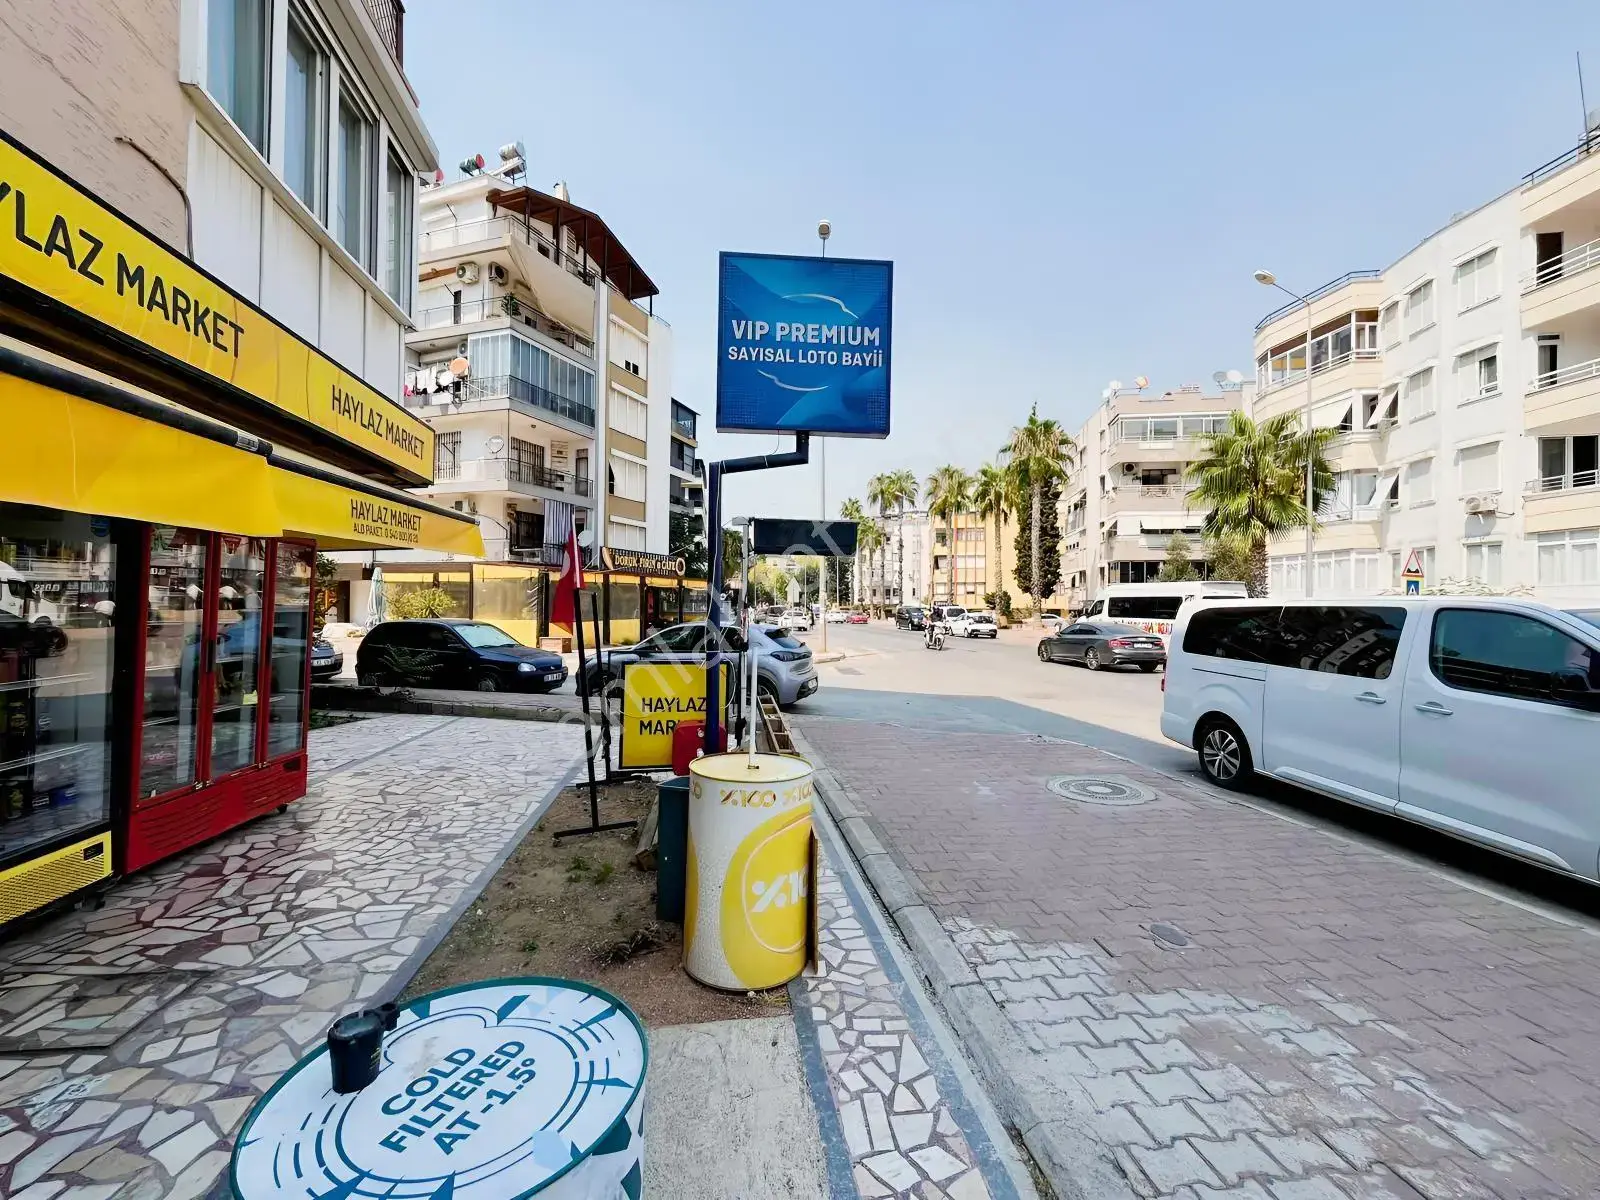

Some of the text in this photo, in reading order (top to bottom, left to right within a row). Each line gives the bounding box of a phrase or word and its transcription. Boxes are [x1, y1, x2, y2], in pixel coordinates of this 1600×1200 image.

[116, 252, 245, 359] MARKET
[731, 319, 880, 346] VIP PREMIUM
[728, 346, 796, 363] SAYISAL
[798, 349, 837, 365] LOTO
[332, 384, 425, 460] HAYLAZ MARKET
[350, 498, 422, 532] HAYLAZ MARKET
[353, 522, 365, 535] ALO
[641, 696, 707, 713] HAYLAZ
[639, 719, 680, 736] MAR
[378, 1041, 525, 1154] FILTERED
[381, 1048, 476, 1116] COLD
[433, 1110, 481, 1156] AT
